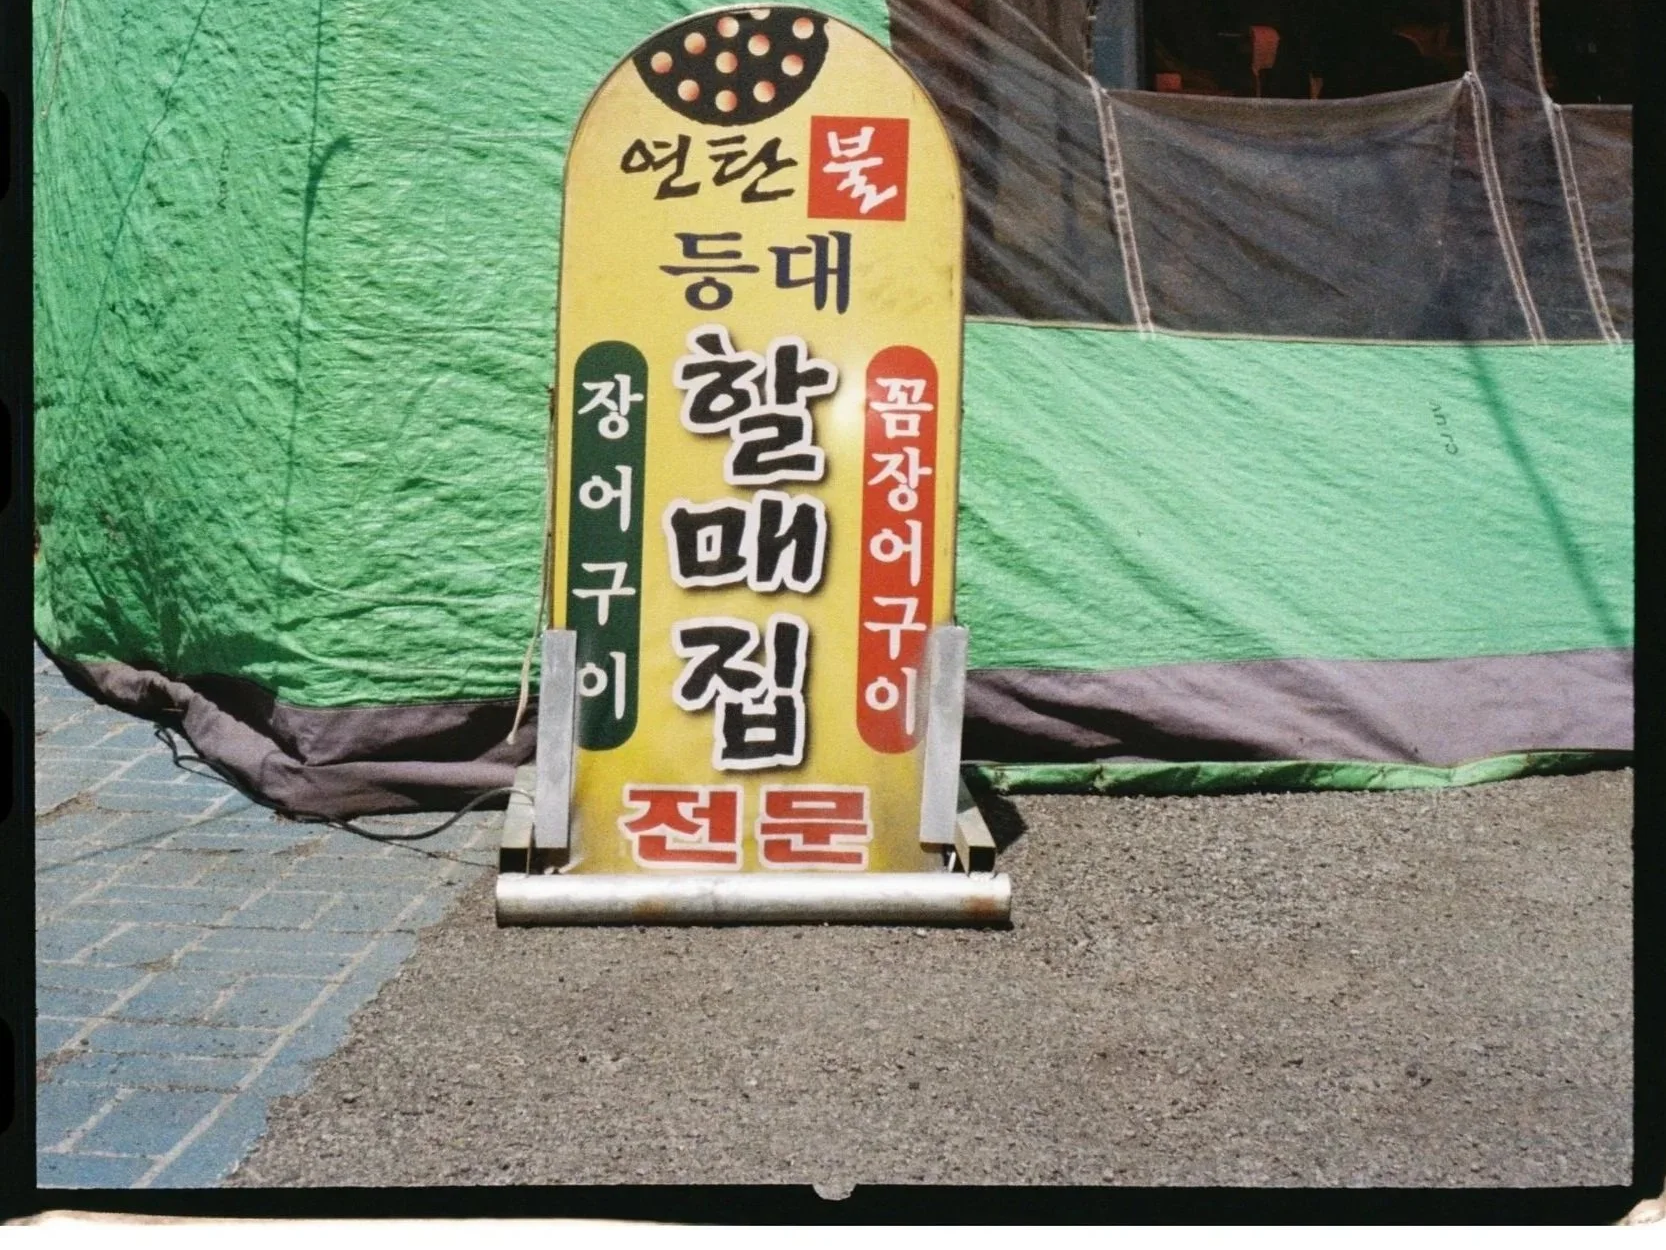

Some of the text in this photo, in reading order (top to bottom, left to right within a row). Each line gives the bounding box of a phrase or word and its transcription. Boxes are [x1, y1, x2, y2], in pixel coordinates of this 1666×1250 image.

[658, 230, 852, 315] 등대
[571, 373, 644, 720] 장어구이
[662, 323, 838, 771] 할매집
[863, 376, 935, 737] 꼼장어구이
[618, 784, 874, 872] 전문
